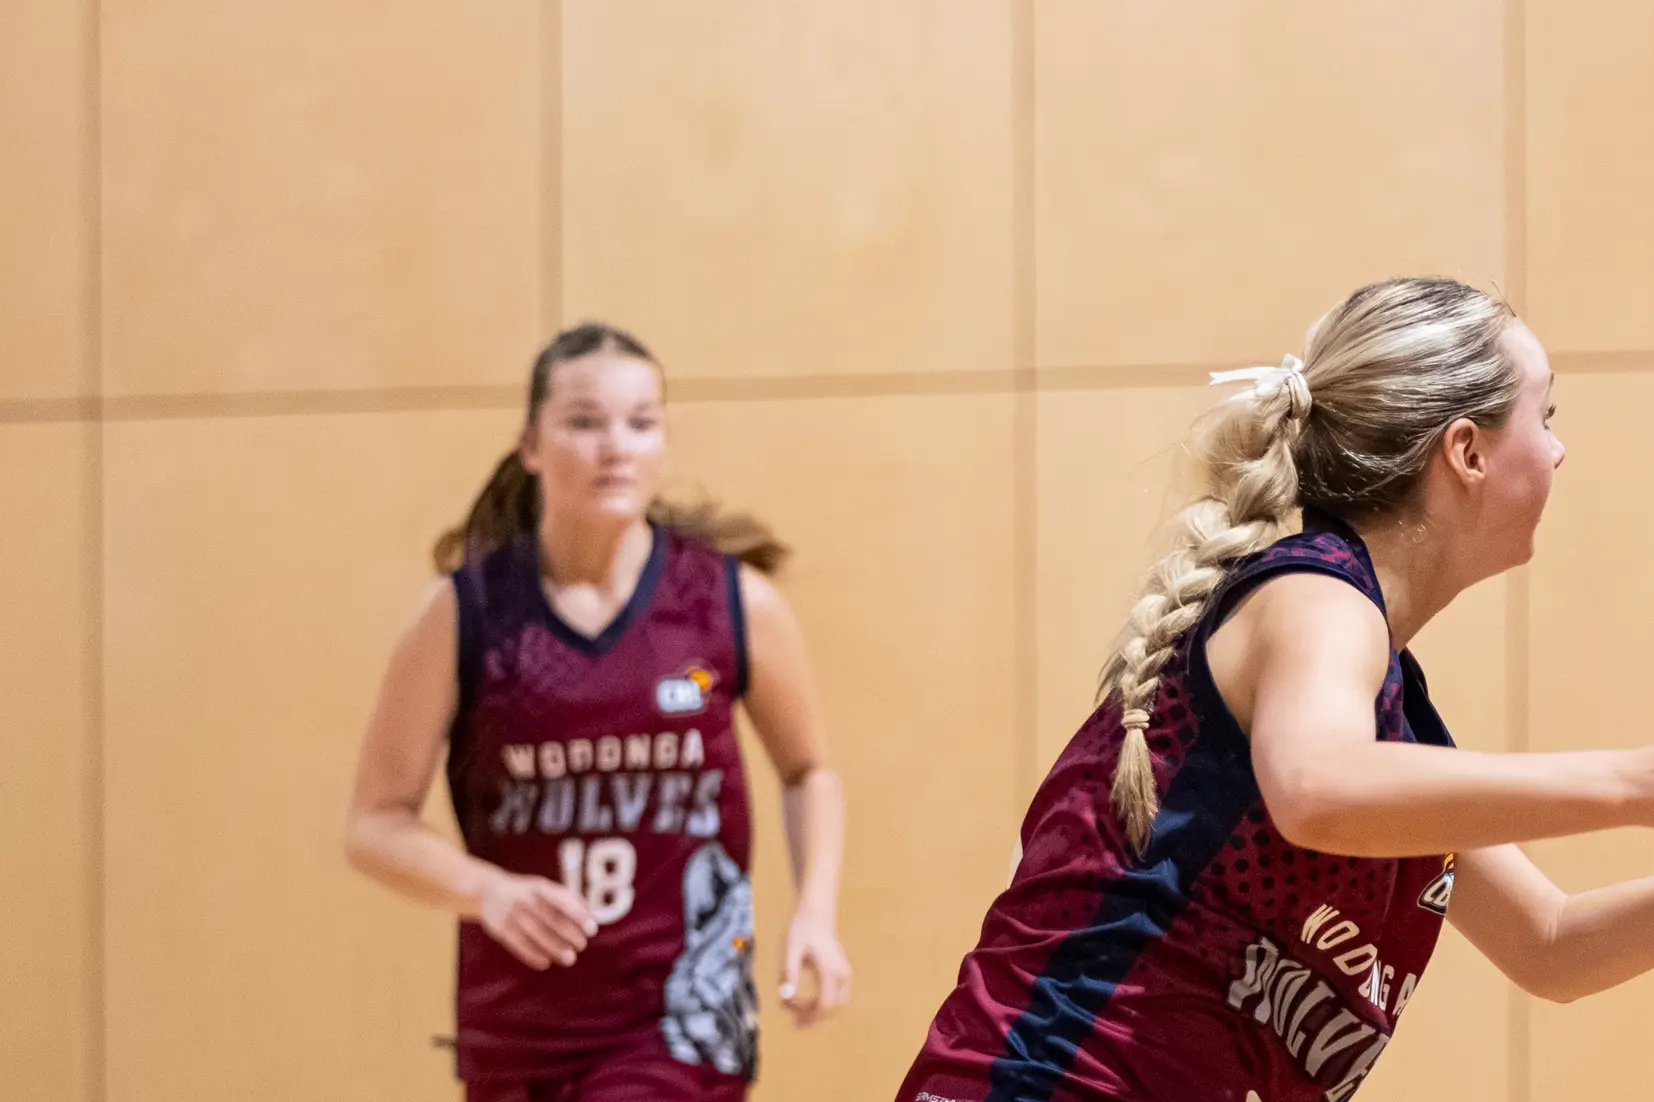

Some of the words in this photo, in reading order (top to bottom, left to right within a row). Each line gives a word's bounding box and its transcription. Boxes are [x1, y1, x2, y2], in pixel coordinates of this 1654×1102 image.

[503, 728, 704, 780] WODONGA
[489, 768, 724, 836] WOLVES
[557, 836, 637, 925] 18
[1300, 904, 1418, 1016] WODGA
